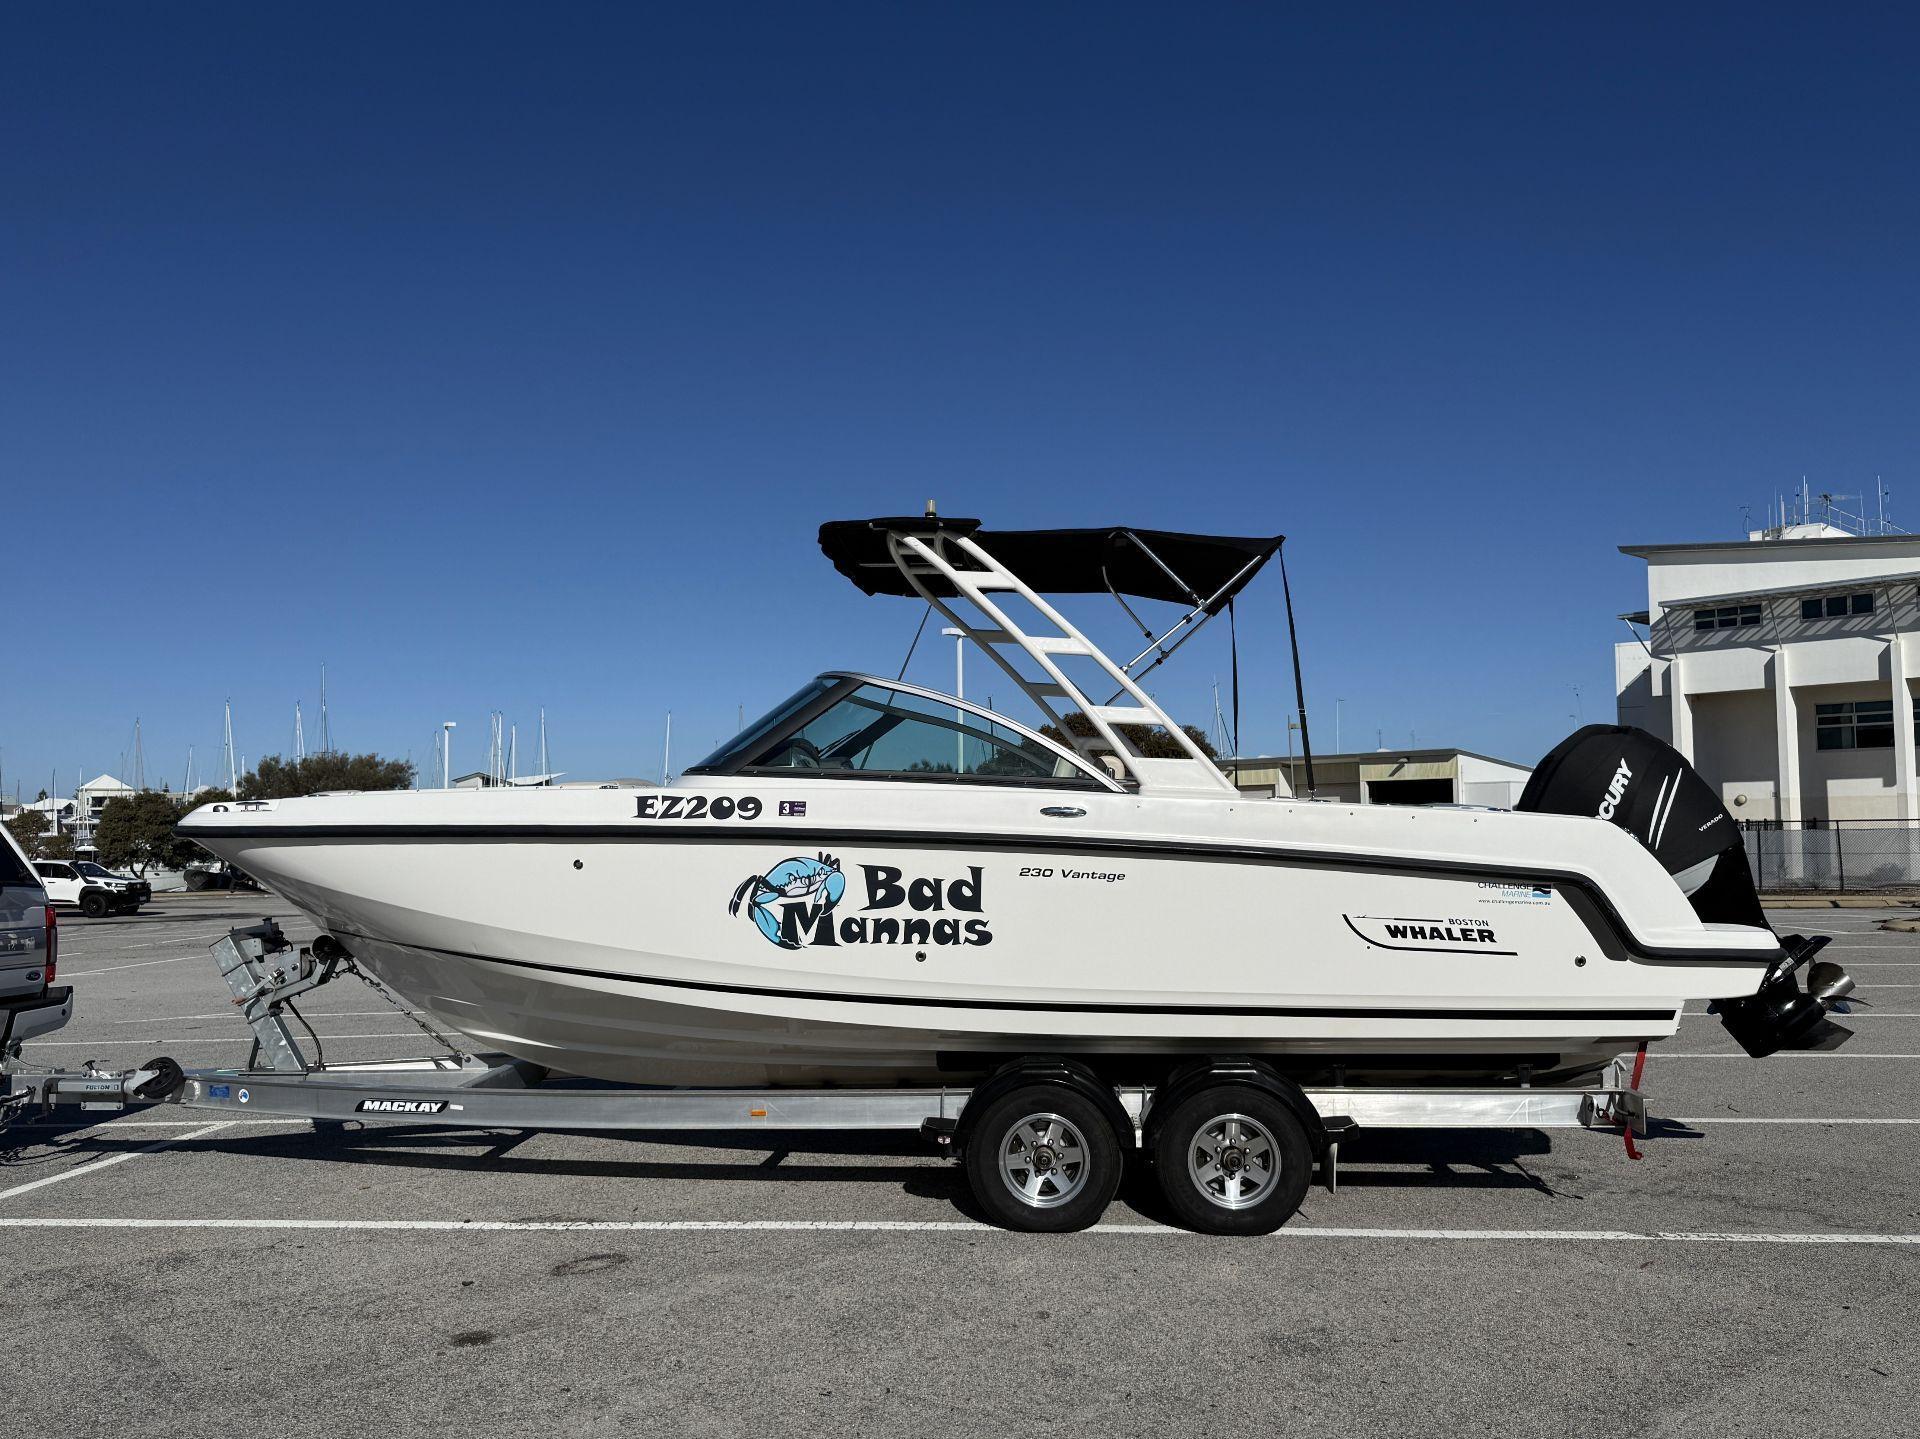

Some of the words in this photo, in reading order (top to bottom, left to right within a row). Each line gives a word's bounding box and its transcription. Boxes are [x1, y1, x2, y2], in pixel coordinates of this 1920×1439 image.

[1595, 757, 1633, 820] CURY
[631, 795, 763, 820] EZ209
[782, 803, 790, 814] 3
[1698, 813, 1723, 832] VERADO
[1018, 867, 1054, 879] 230
[1061, 869, 1126, 883] Vantage
[856, 863, 985, 913] Bad
[1477, 881, 1533, 891] CHALLENGE
[1501, 890, 1532, 898] MARINE
[778, 901, 994, 948] Mannas
[1448, 918, 1489, 927] BOSTON
[1384, 924, 1498, 944] WHALER
[362, 1100, 443, 1112] MACKAY
